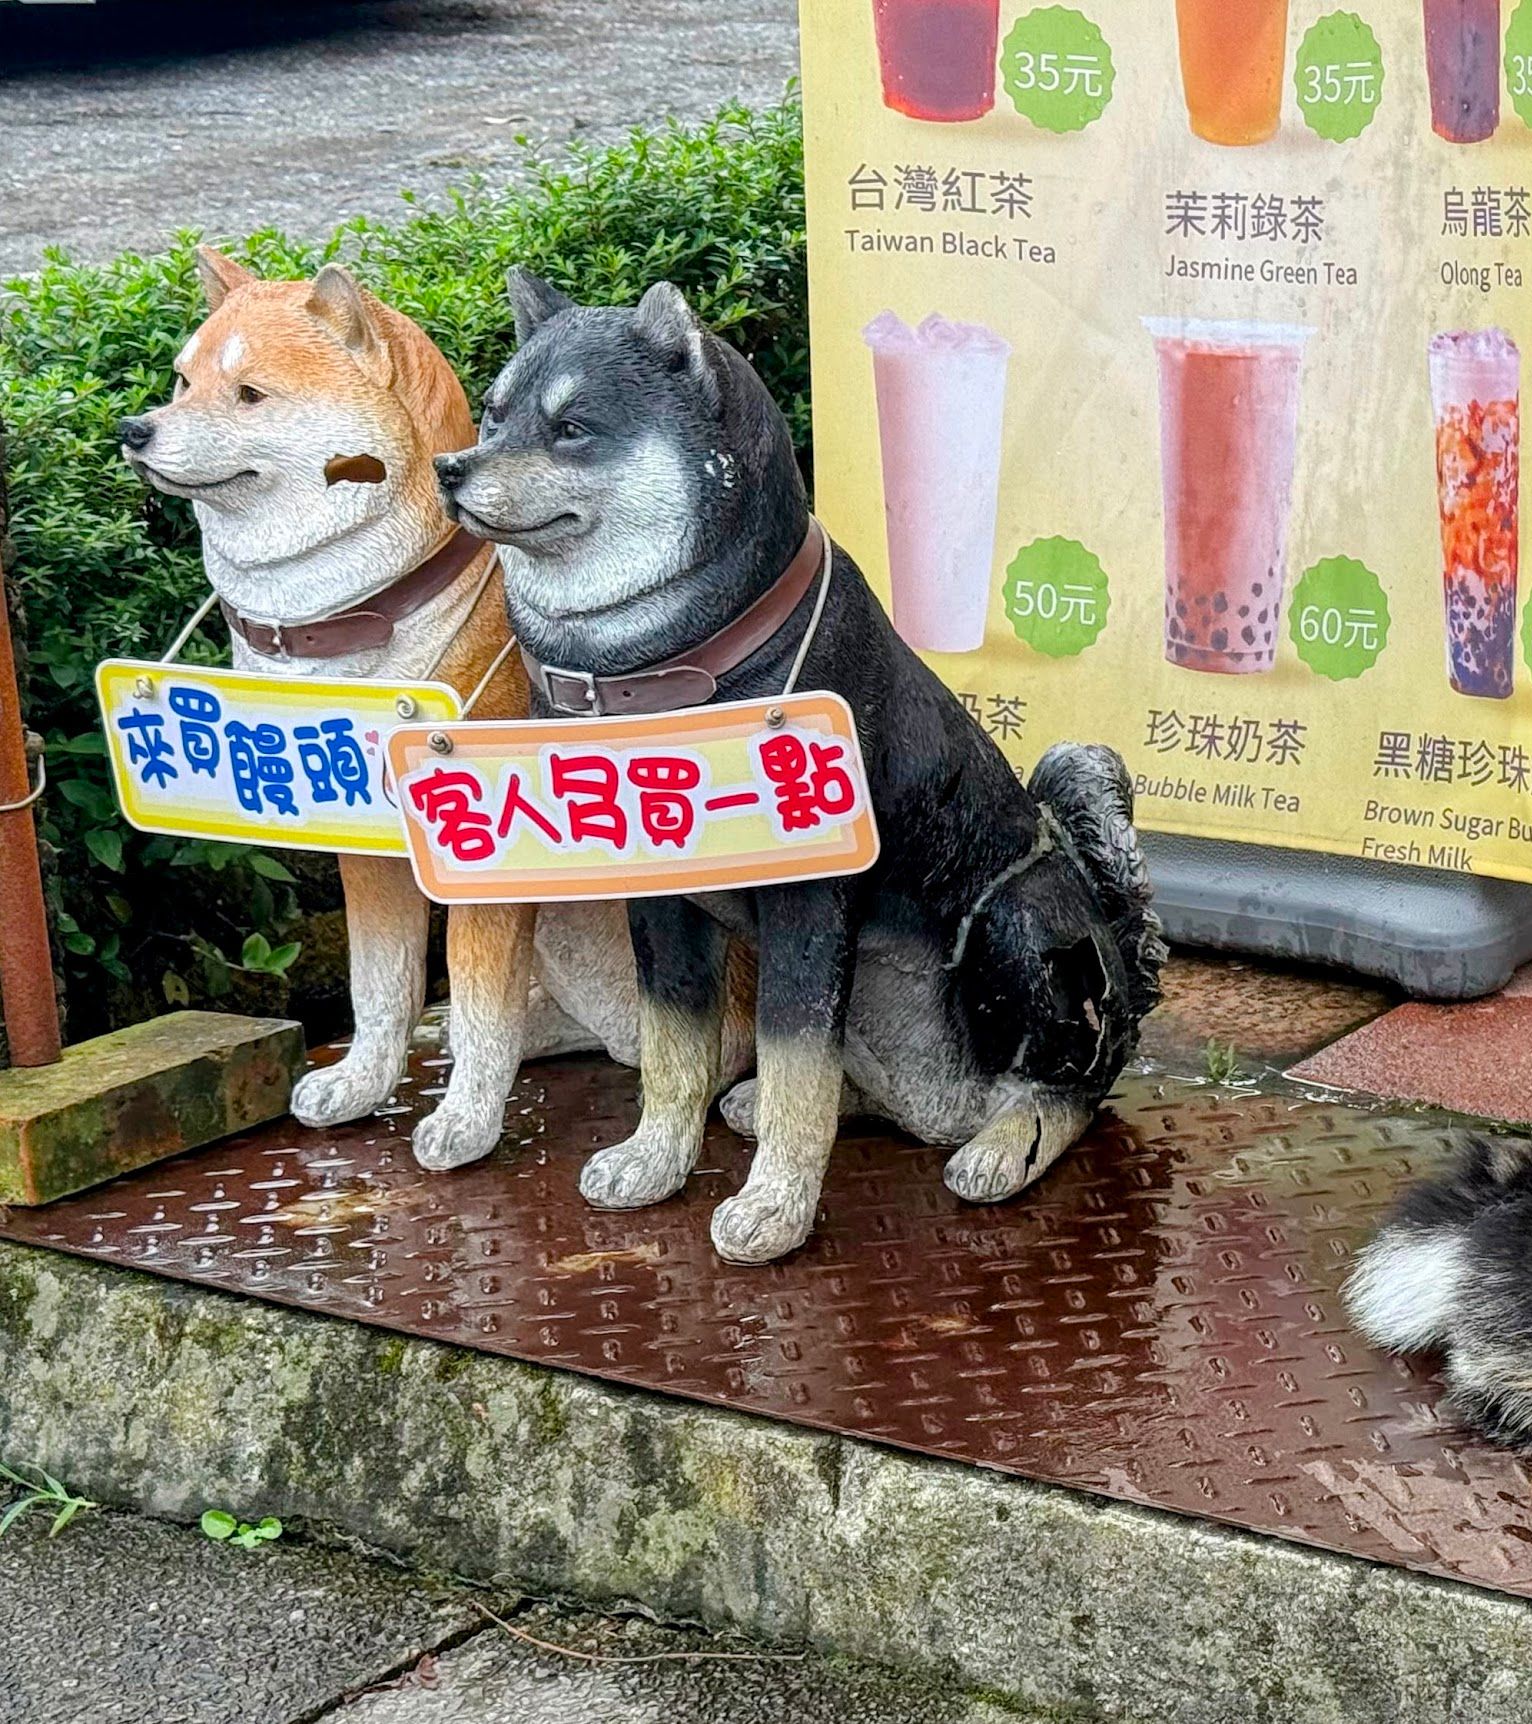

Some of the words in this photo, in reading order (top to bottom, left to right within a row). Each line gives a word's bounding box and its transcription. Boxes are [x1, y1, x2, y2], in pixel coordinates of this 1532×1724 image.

[1013, 52, 1104, 100] 35元
[1304, 61, 1376, 106] 35元
[848, 163, 1034, 220] 台灣紅茶
[1441, 186, 1531, 238] 烏龍茶
[844, 229, 934, 253] Taiwan
[942, 231, 1007, 260] Black
[1013, 238, 1056, 264] Tea
[1165, 254, 1255, 282] Jasmine
[1260, 259, 1318, 286] Green
[1323, 262, 1358, 286] Tea
[1441, 260, 1491, 292] Olong
[1494, 262, 1523, 287] Tea
[1014, 578, 1098, 627] 50元
[1299, 606, 1380, 651] 60元
[117, 686, 372, 816] 來買饅頭
[1143, 709, 1308, 766] 珍珠奶茶
[1134, 774, 1207, 803] Bubble
[1212, 783, 1256, 808] Milk
[1261, 787, 1300, 813] Tea
[1363, 800, 1434, 827] Brown
[1439, 807, 1504, 841] Sugar
[1361, 837, 1421, 863] Fresh
[1428, 844, 1473, 871] Milk
